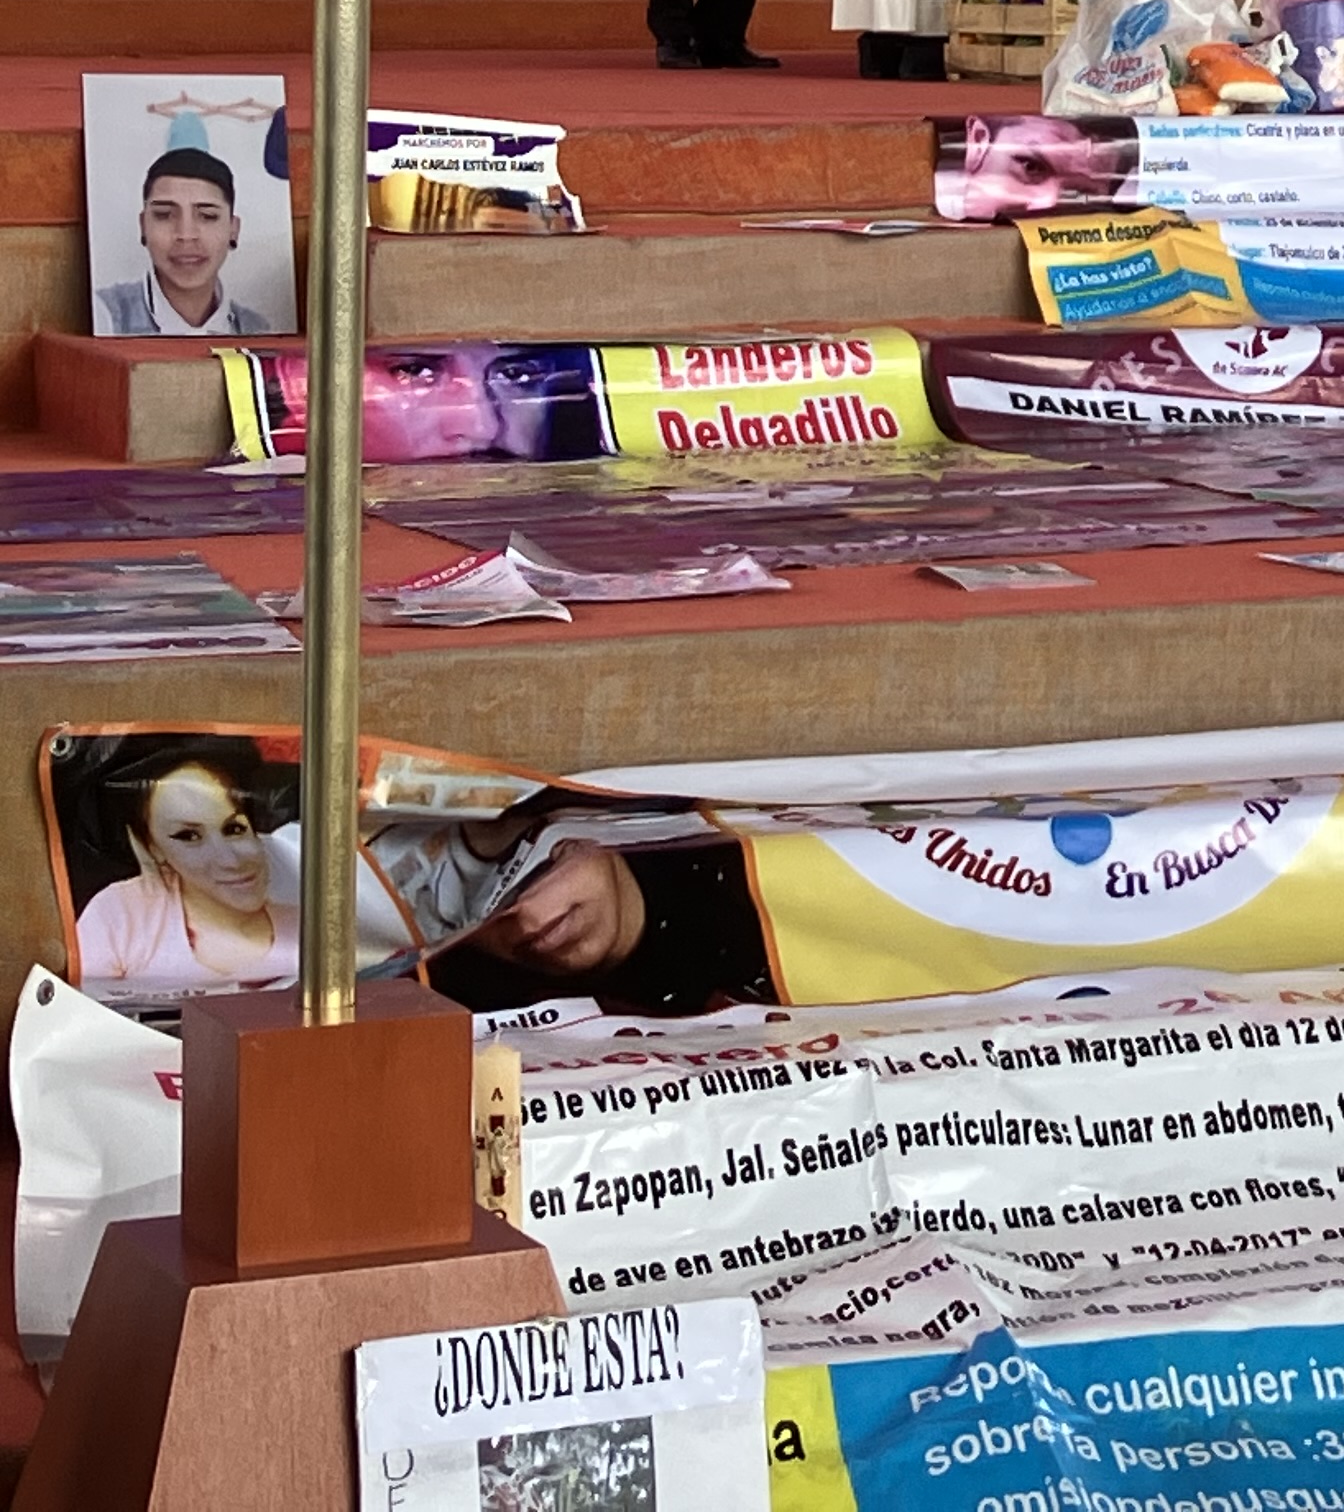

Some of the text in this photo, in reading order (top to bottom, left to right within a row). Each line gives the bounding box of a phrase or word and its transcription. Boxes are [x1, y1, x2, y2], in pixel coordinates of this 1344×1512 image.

[1037, 225, 1104, 246] Persona
[653, 338, 873, 390] Landeros
[657, 394, 900, 452] Delgadillo
[1009, 391, 1151, 423] DANIEL
[924, 817, 1258, 899] Unidos En Busca
[487, 1008, 561, 1035] Julio
[553, 1089, 584, 1120] le
[592, 1085, 636, 1114] vio
[643, 1076, 691, 1114] por
[799, 1058, 849, 1084] vez
[885, 1055, 916, 1077] la
[919, 1045, 979, 1070] Col.
[982, 1038, 1061, 1072] Santa
[1064, 1027, 1201, 1068] Margarita
[1207, 1023, 1233, 1050] el
[1286, 1015, 1319, 1046] 12
[529, 1188, 566, 1220] en
[573, 1162, 714, 1217] Zapopan,
[721, 1142, 775, 1188] Jal.
[781, 1120, 889, 1178] Señales
[895, 1108, 1073, 1156] particulares:
[1074, 1114, 1154, 1148] Lunar
[1162, 1111, 1197, 1140] en
[1203, 1098, 1334, 1138] abdomen,
[568, 1265, 606, 1297] de
[614, 1259, 667, 1289] ave
[674, 1250, 714, 1279] en
[720, 1220, 867, 1272] antebrazo
[1003, 1203, 1057, 1230] una
[1062, 1192, 1185, 1226] calavera
[1190, 1185, 1242, 1212] con
[1244, 1174, 1337, 1204] flores,
[433, 1303, 686, 1419] ¿DONDE ESTA?
[1084, 1361, 1298, 1419] cualquier
[923, 1414, 1062, 1477] sobre
[1110, 1435, 1297, 1474] persona
